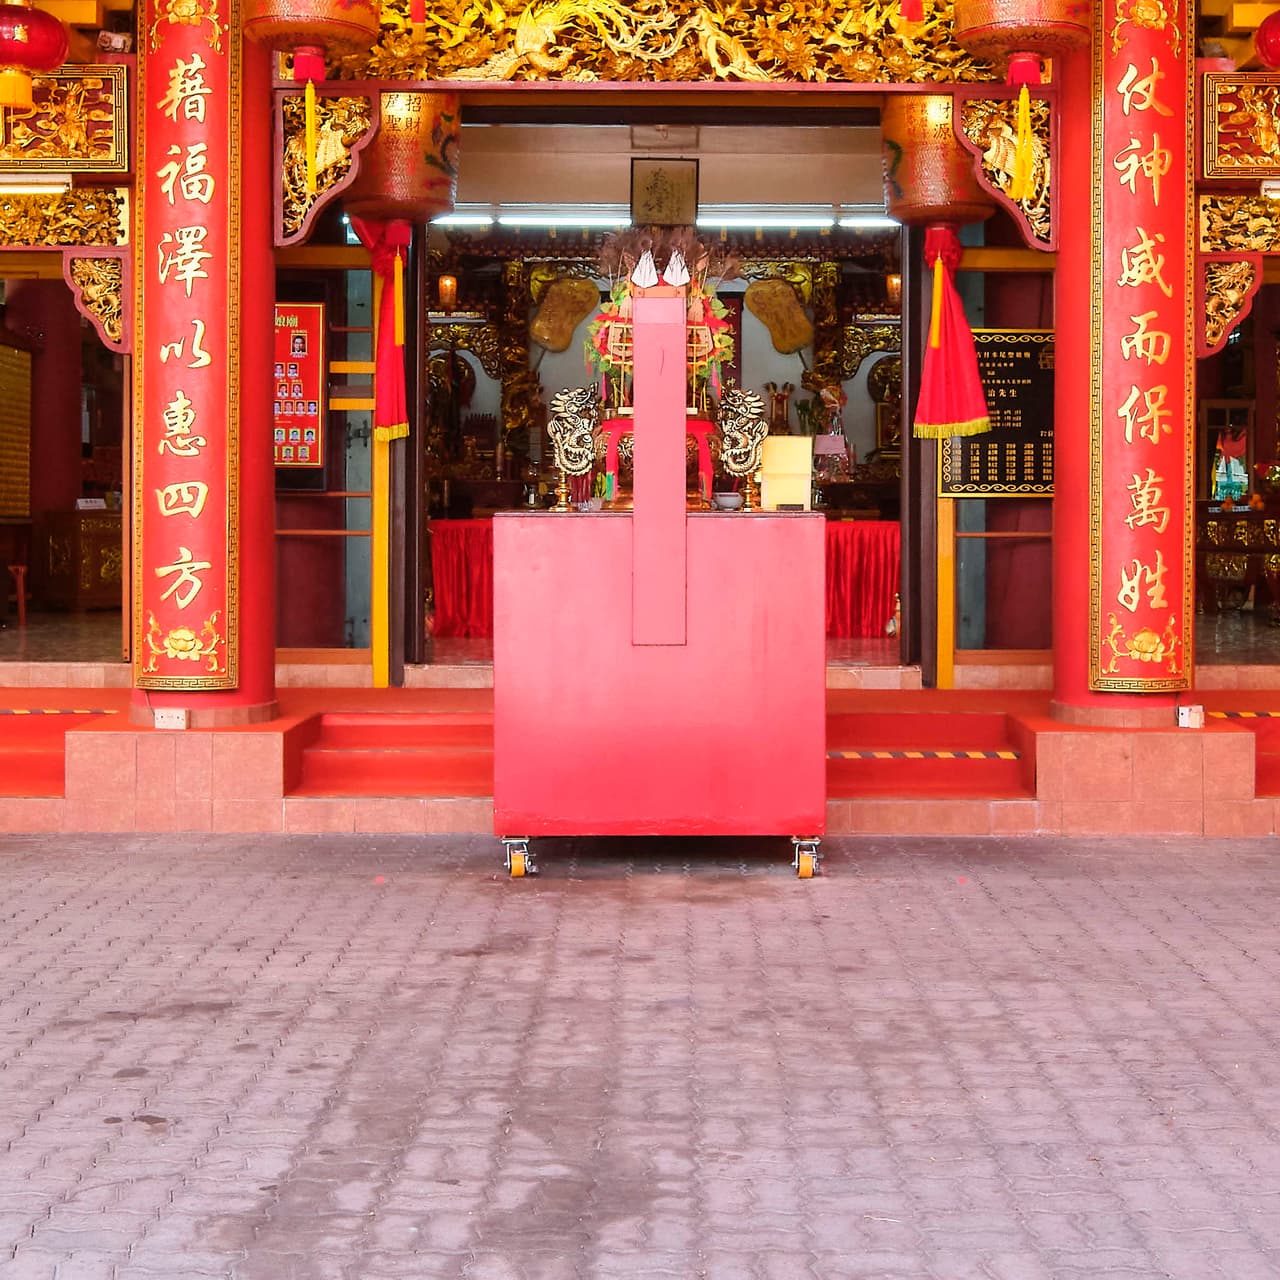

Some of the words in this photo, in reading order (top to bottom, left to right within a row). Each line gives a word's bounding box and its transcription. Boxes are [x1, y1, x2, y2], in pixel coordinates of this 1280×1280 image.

[1114, 59, 1174, 612] 仗神威而保萬姓
